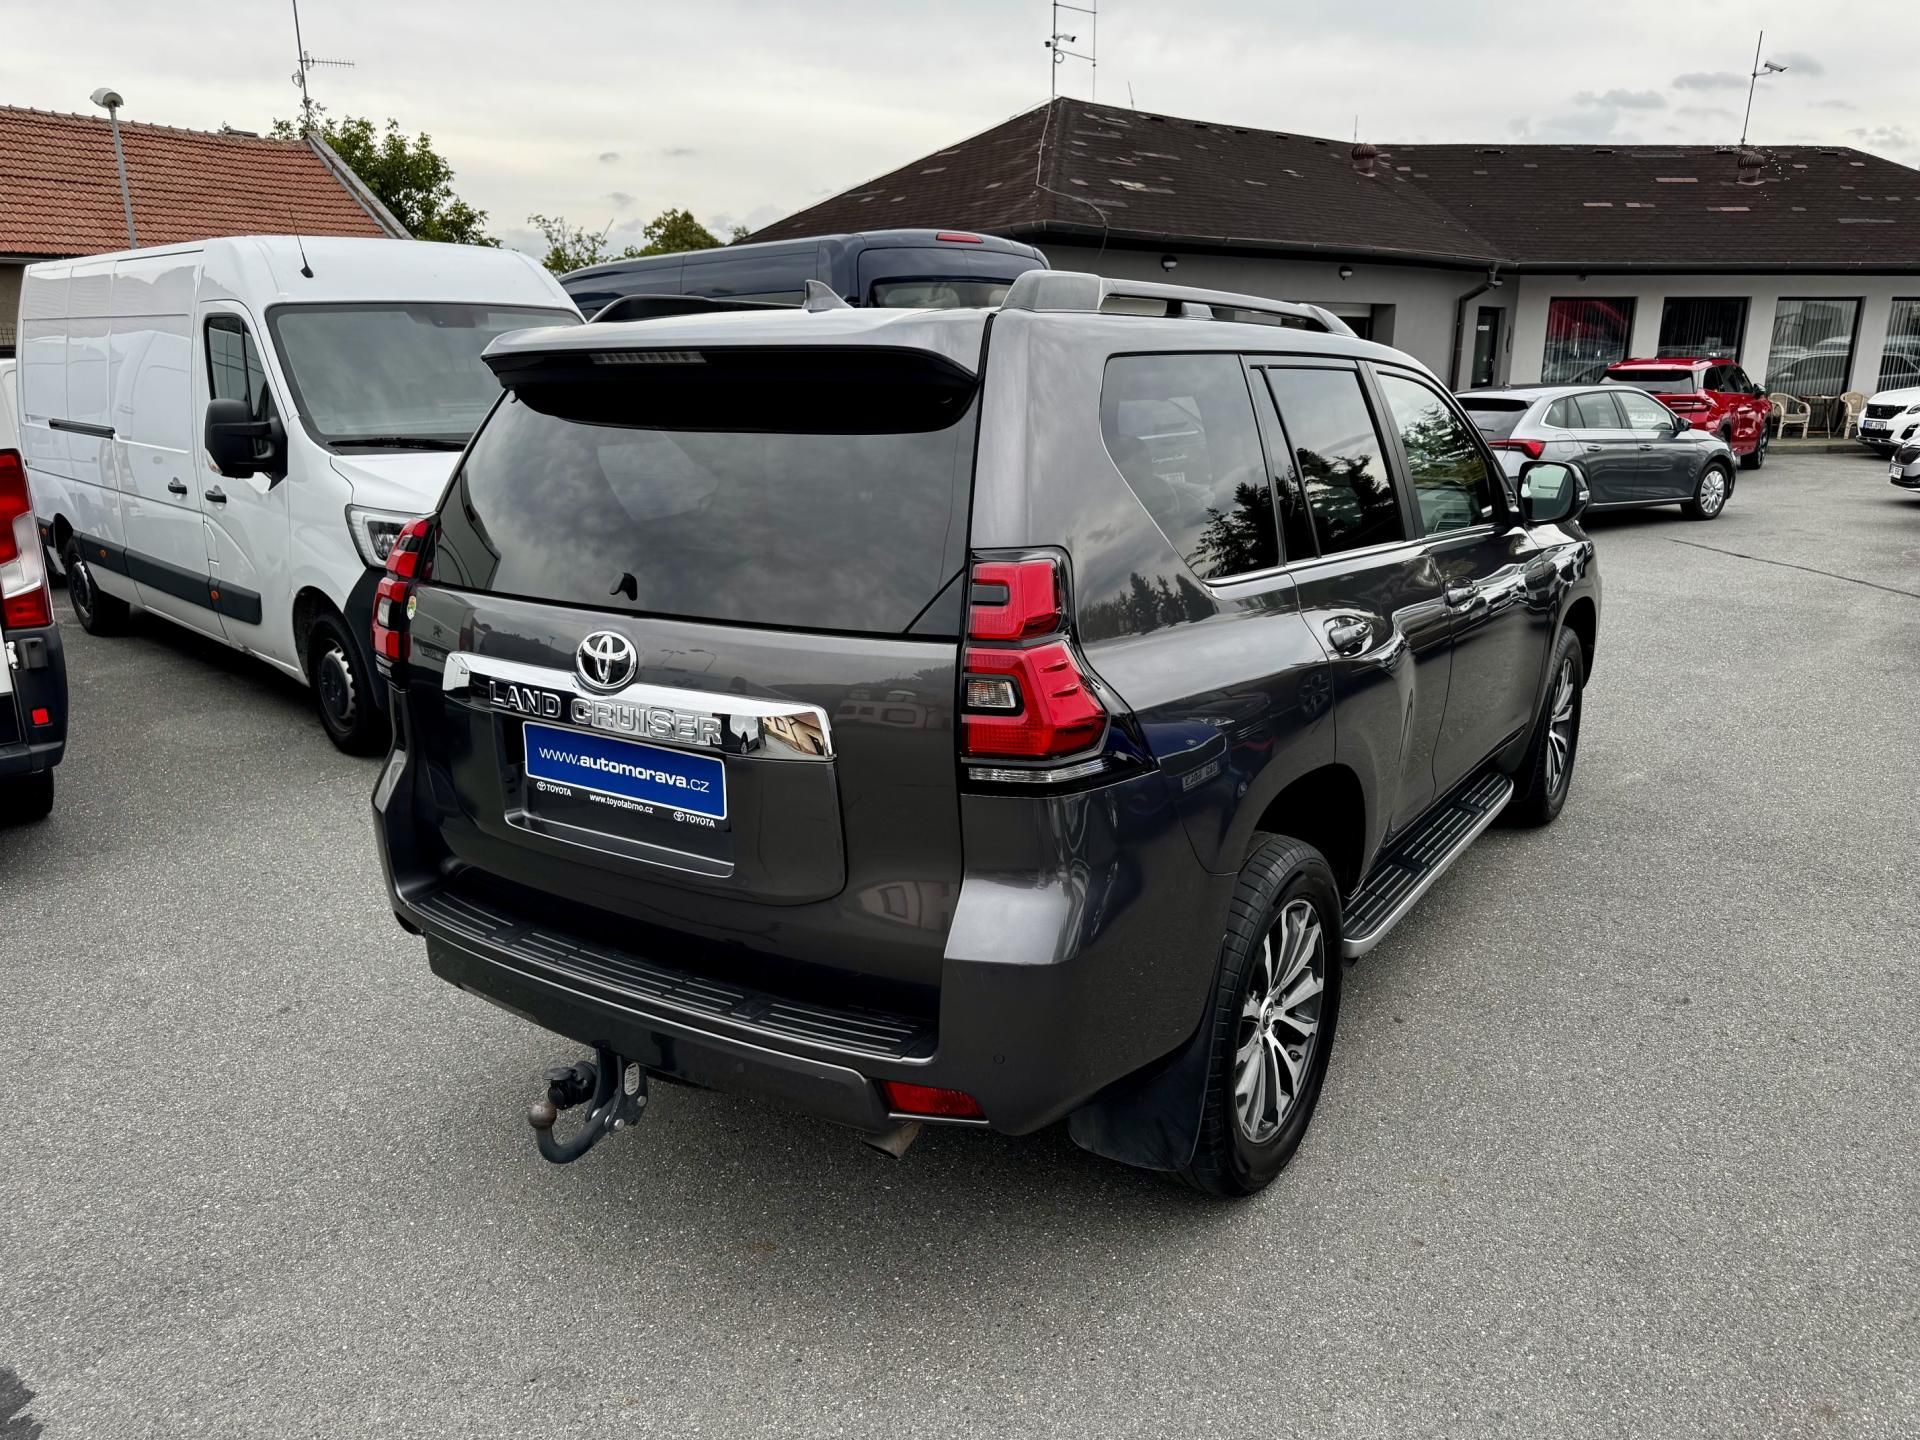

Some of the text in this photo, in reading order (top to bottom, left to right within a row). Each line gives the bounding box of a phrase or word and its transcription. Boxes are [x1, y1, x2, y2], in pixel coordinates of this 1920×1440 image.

[489, 680, 723, 746] LAND CRUISER
[538, 747, 710, 793] www.automorava.cz
[546, 783, 572, 797] TOYOTA
[589, 793, 654, 814] www.toyotabrno.cz
[685, 814, 716, 829] TOYOTA
